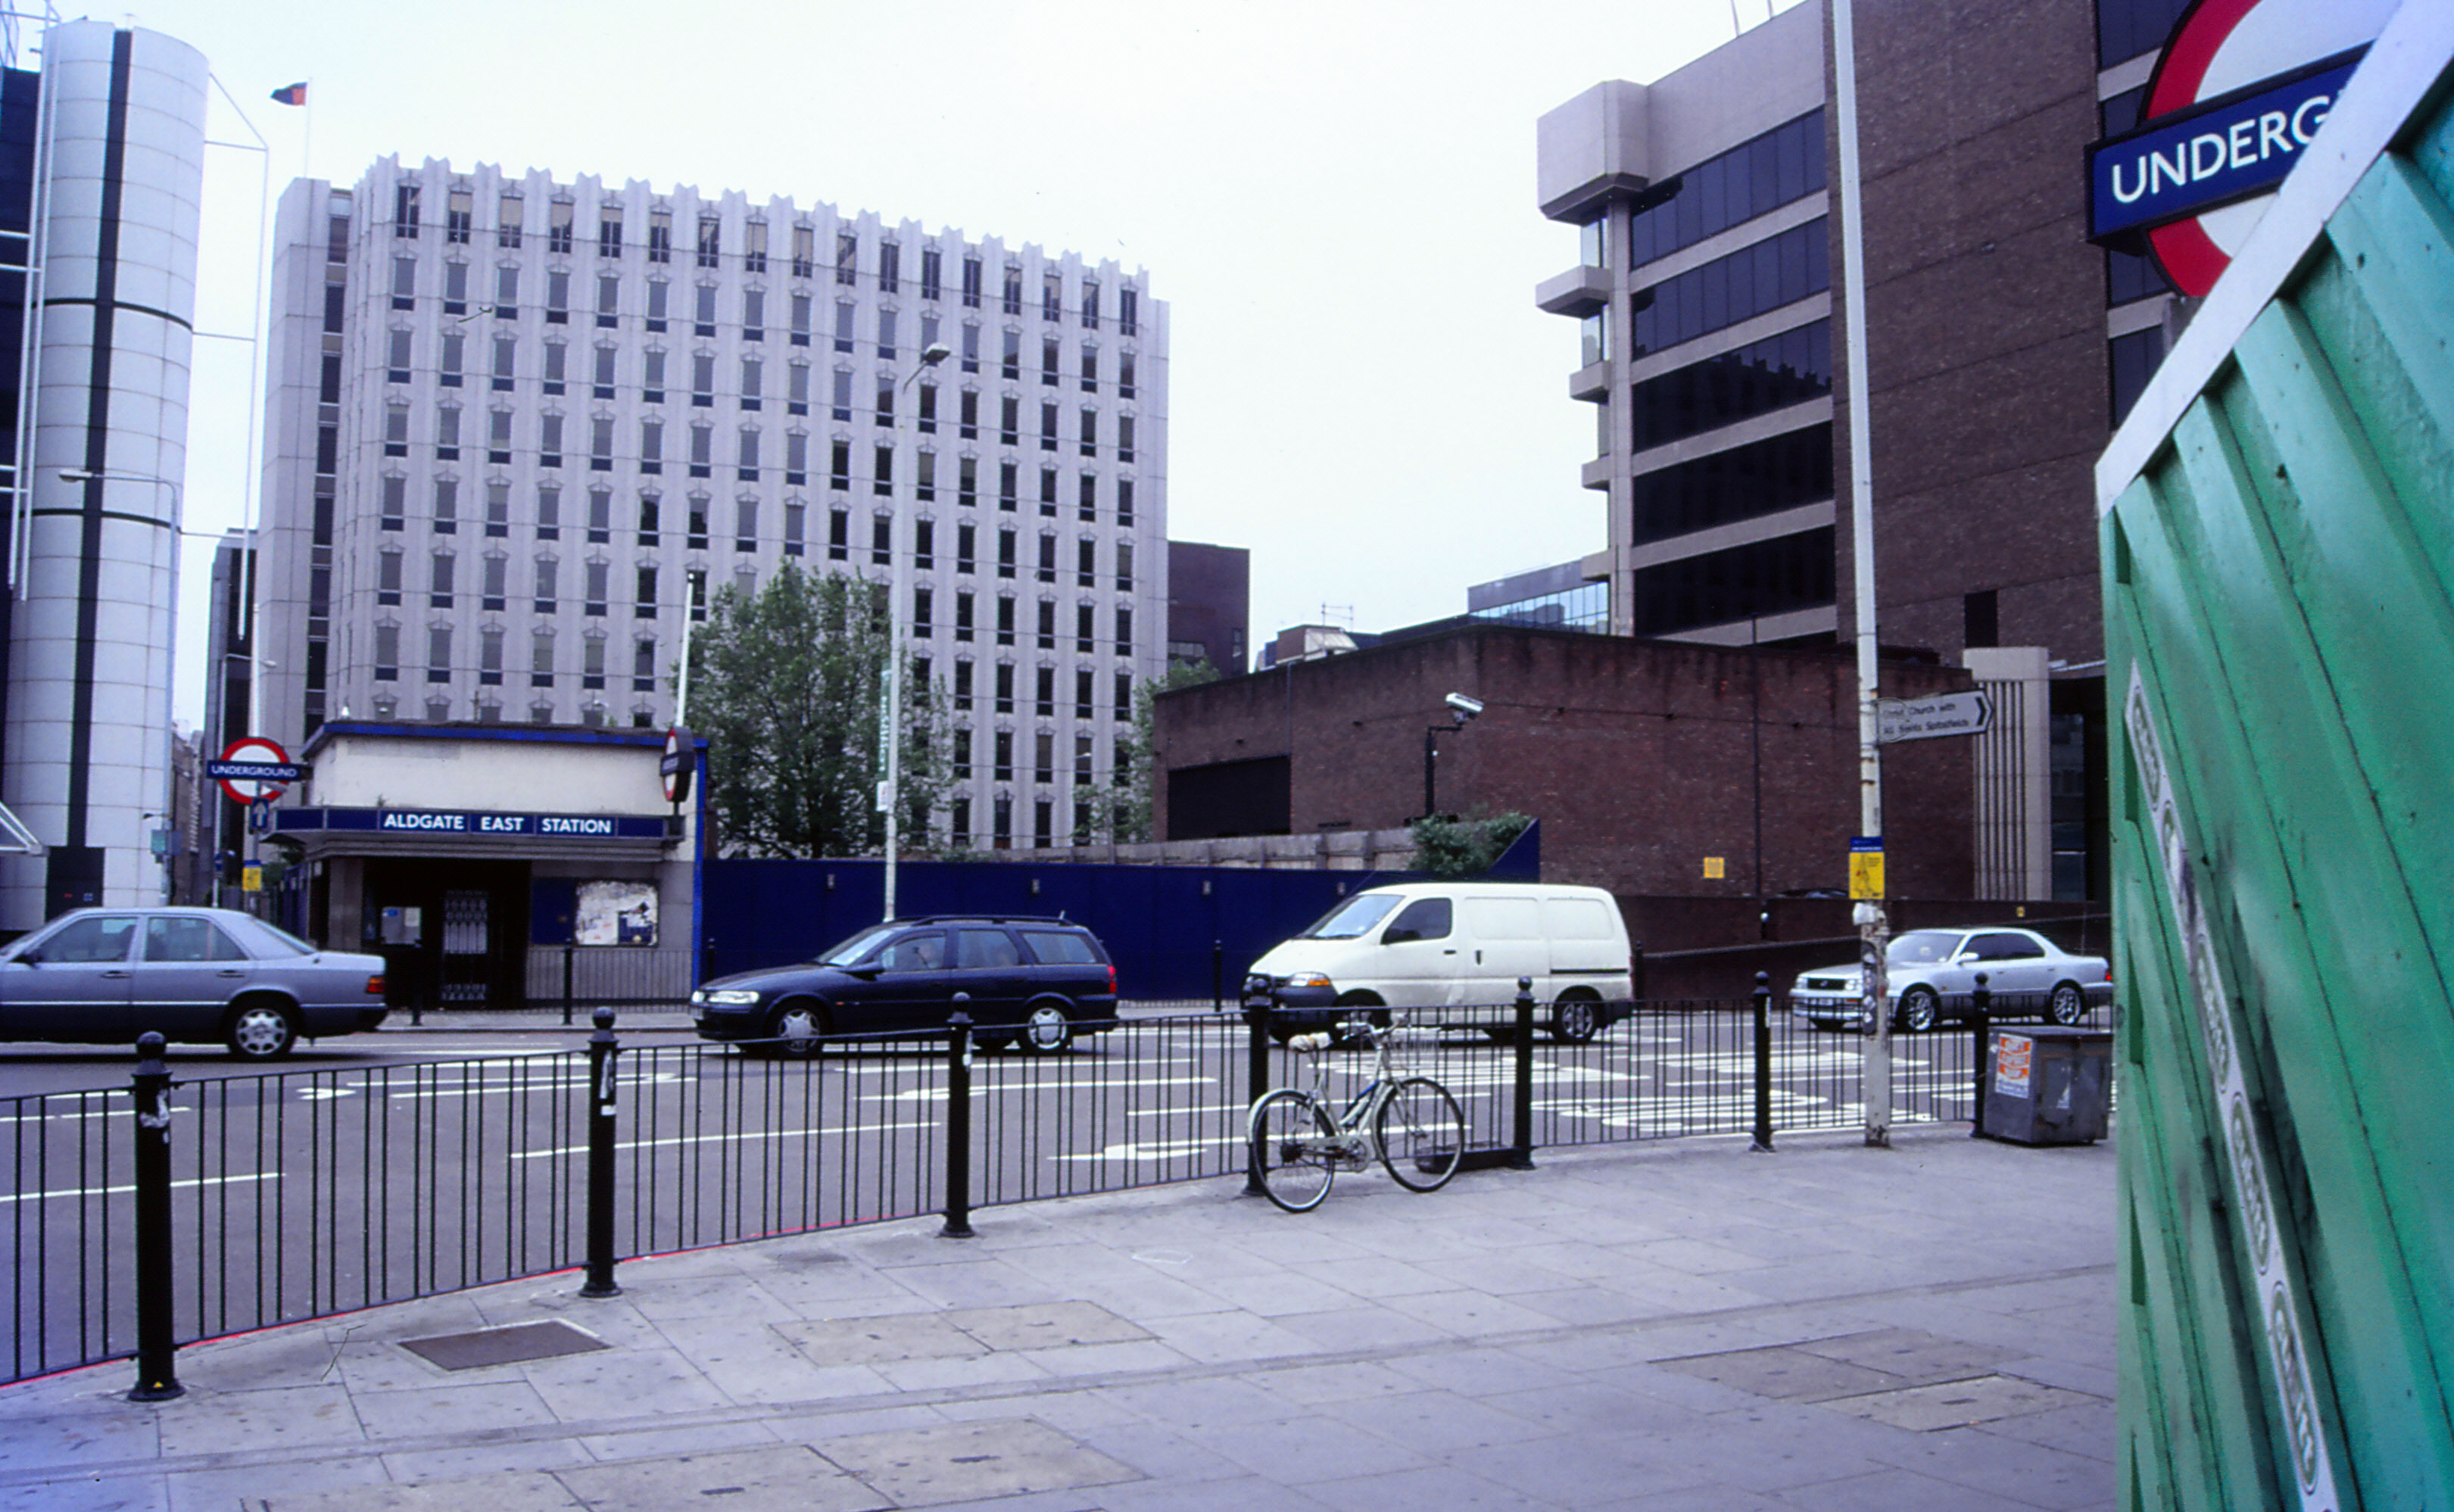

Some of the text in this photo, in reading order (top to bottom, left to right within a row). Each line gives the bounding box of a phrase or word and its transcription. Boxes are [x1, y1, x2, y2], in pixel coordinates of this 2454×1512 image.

[2111, 95, 2331, 205] UNDERG
[1908, 706, 1935, 715] Church
[1939, 703, 1957, 712] with
[210, 765, 298, 778] UNDERGROUND
[384, 813, 612, 834] ALDGATE EAST STATION
